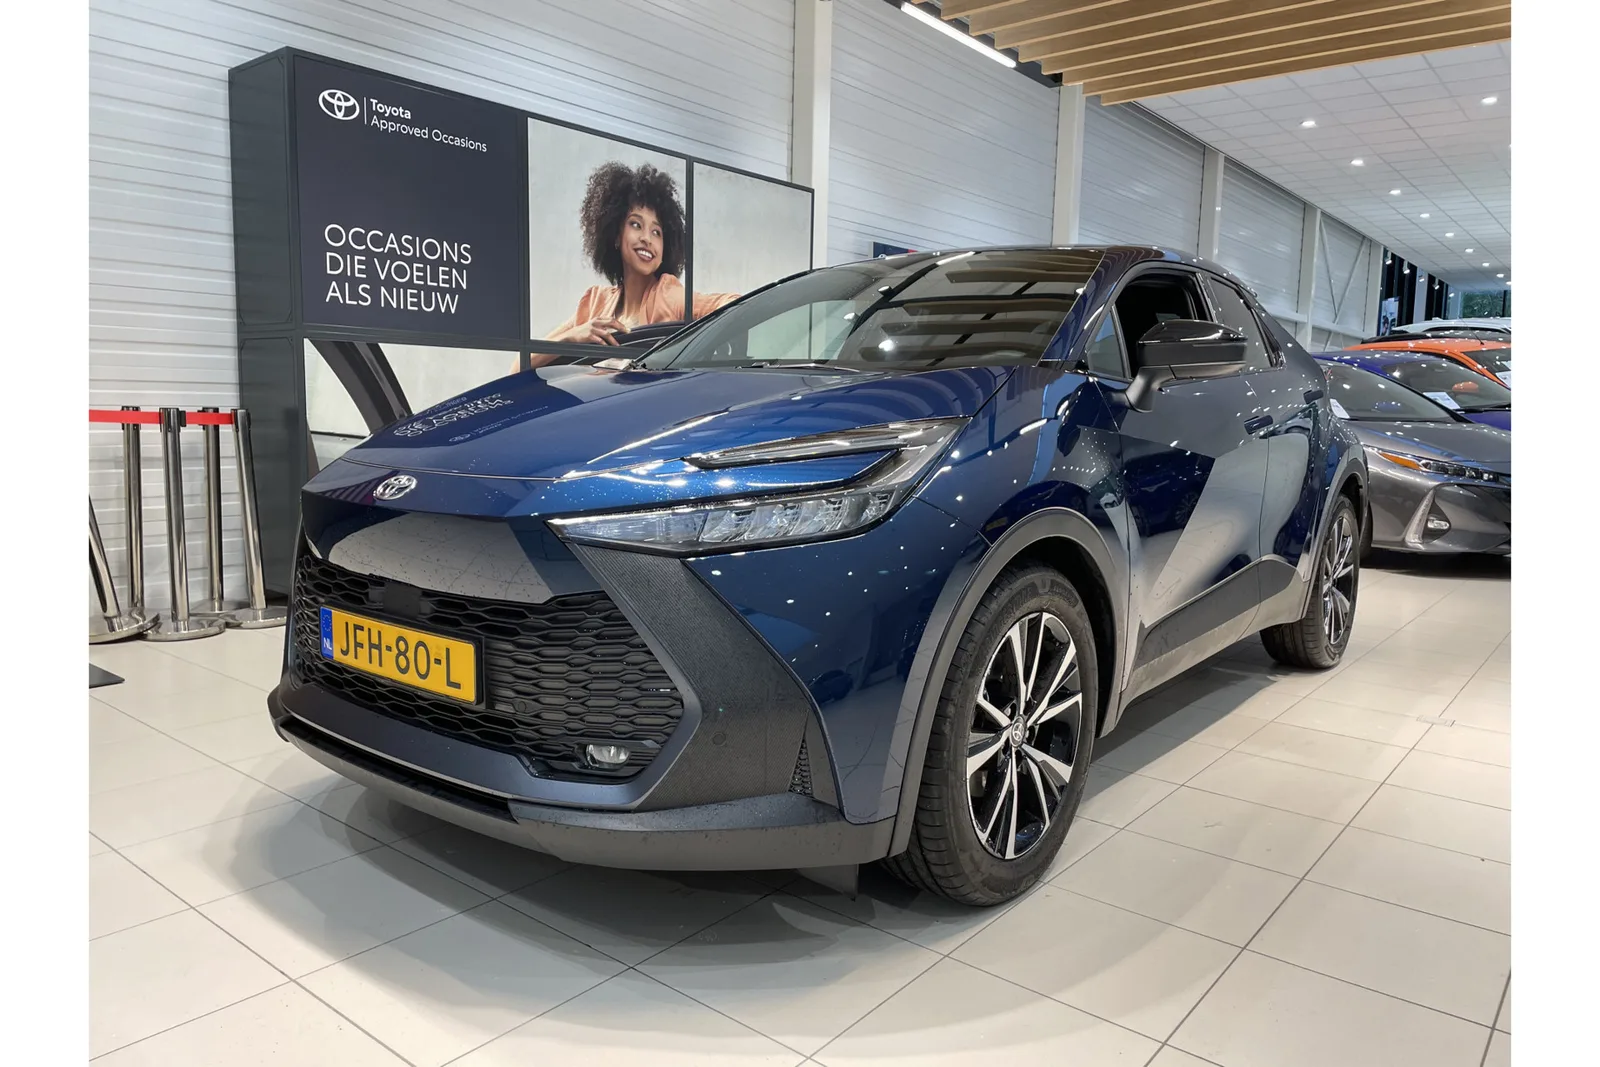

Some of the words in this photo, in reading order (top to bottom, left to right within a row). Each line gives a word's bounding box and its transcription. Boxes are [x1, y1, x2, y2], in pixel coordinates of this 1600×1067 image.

[370, 98, 411, 119] Toyota
[371, 115, 428, 139] Approved
[431, 129, 487, 152] Occasions
[324, 223, 472, 265] OCCASIONS
[326, 252, 367, 278] DIE
[374, 258, 467, 289] VOELEN
[325, 281, 371, 306] ALS
[380, 286, 458, 314] NIEUW
[323, 637, 333, 651] NL
[340, 621, 461, 690] JFH-80-L
